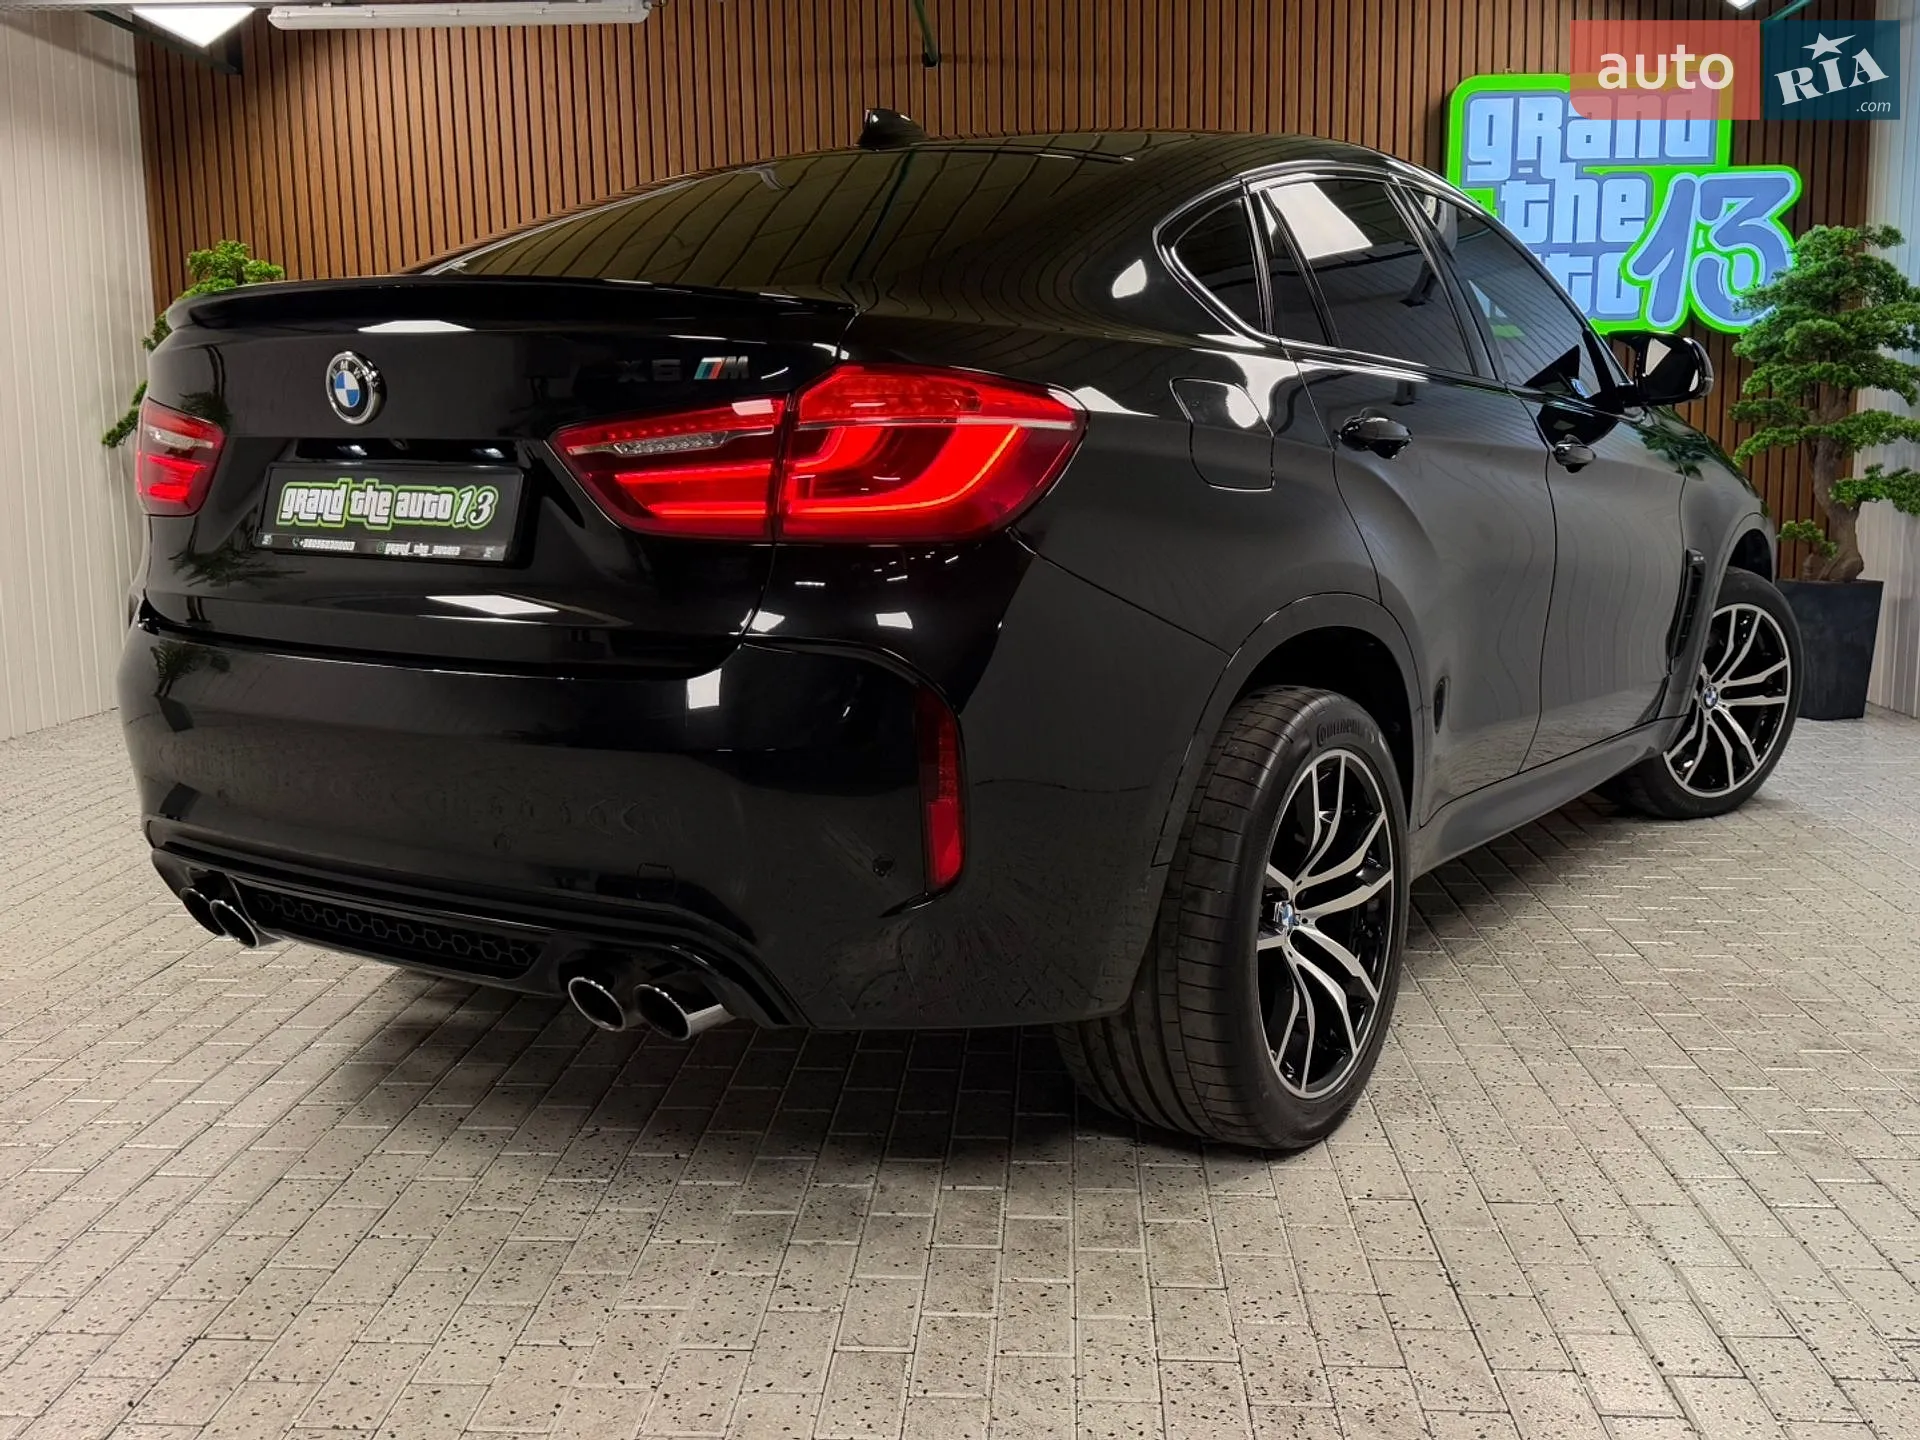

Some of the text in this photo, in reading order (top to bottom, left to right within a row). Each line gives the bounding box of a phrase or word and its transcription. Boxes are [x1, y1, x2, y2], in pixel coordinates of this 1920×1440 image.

[1500, 162, 1648, 244] the
[1629, 173, 1794, 328] 13
[614, 359, 682, 383] X6
[349, 484, 393, 524] the
[454, 489, 497, 524] 13
